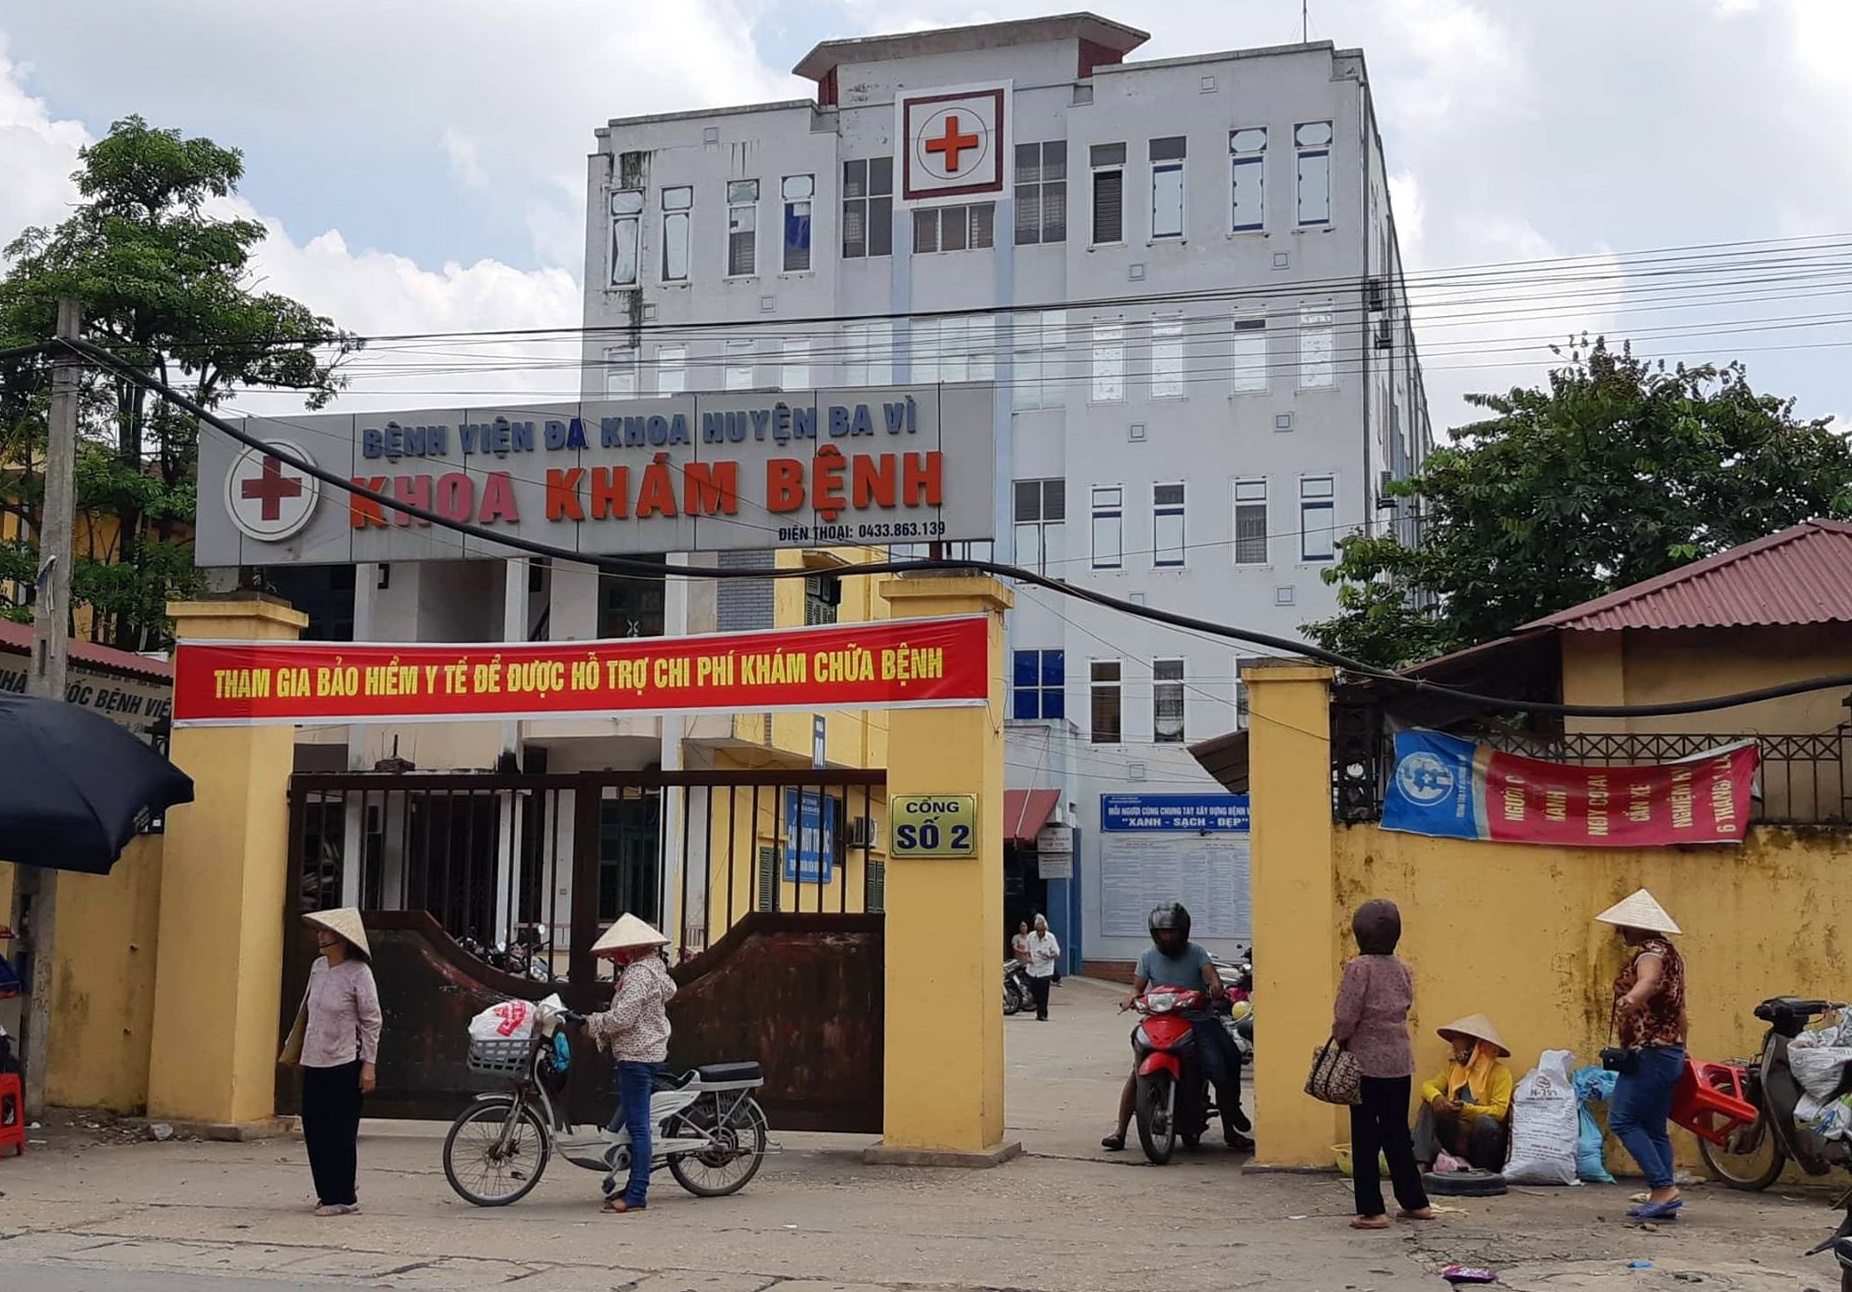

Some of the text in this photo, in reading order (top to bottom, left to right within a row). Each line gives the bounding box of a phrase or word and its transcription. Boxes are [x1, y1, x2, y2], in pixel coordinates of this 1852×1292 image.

[363, 395, 917, 463] BỆNH VIỆN ĐA KHOA HUYỆN BA VÌ
[349, 443, 944, 530] KHOA KHÁM BỆNH
[778, 520, 946, 543] ĐIỆN THOẠI: 0433.863.139
[214, 643, 943, 699] THAM GIA BẢO HIỂM Y TẾ ĐỂ ĐƯỢC HỖ TRỢ CHI PHÍ KHÁM CHỮA BỆNH
[94, 688, 143, 715] BỆNH
[905, 796, 960, 814] CỔNG
[896, 815, 971, 850] SỐ 2
